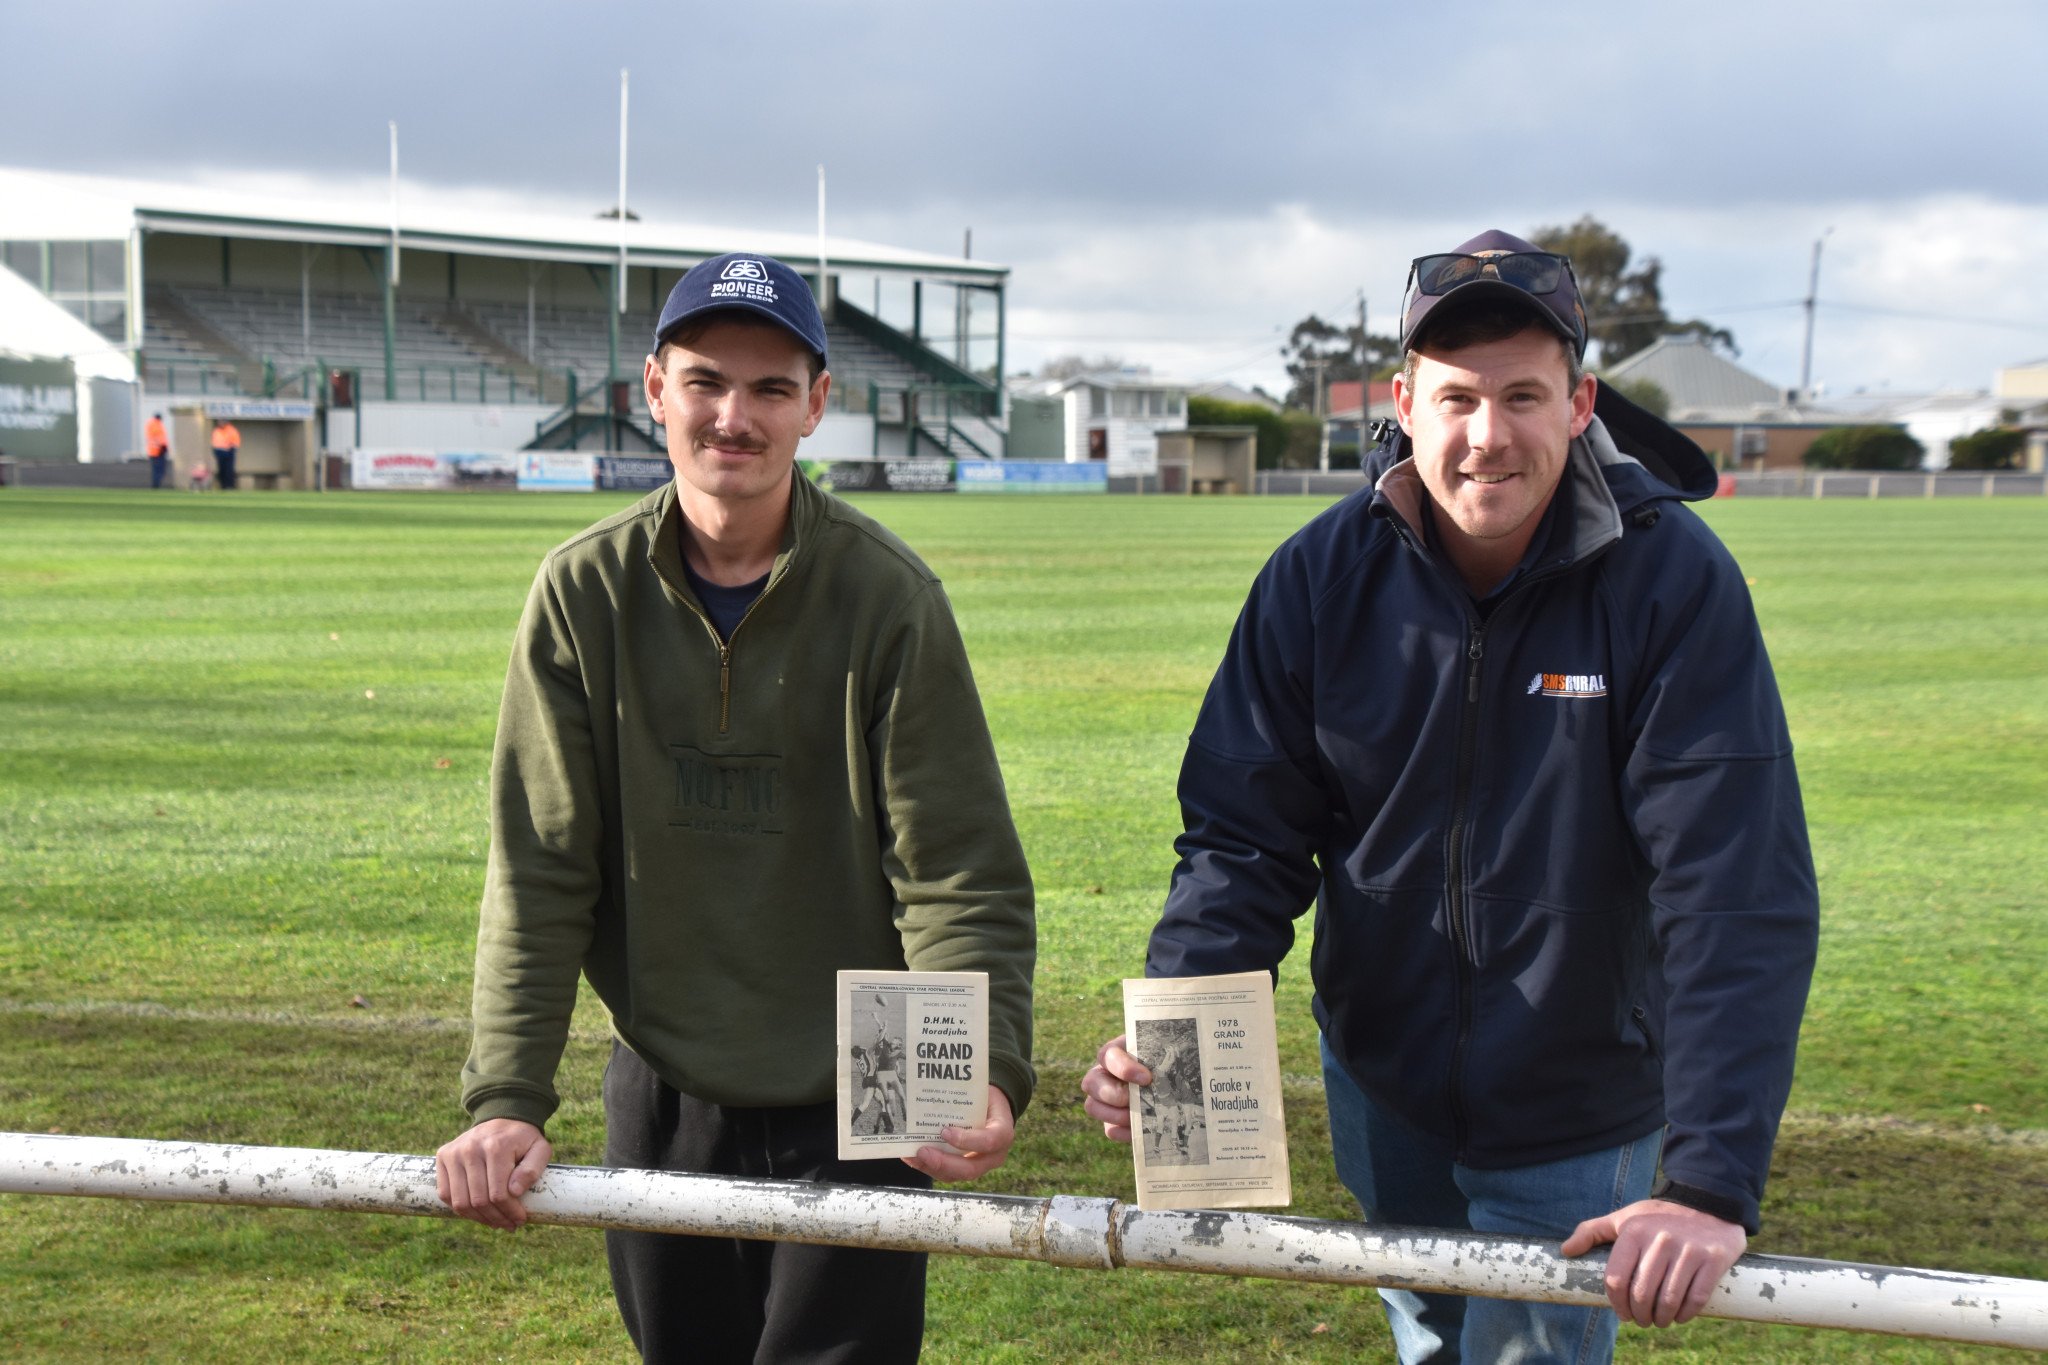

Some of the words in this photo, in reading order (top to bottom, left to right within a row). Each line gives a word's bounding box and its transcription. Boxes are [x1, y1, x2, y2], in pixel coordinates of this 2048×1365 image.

[712, 281, 773, 297] PIONEER
[1217, 1019, 1239, 1027] 1978
[921, 1027, 968, 1037] Noradjuha
[1213, 1030, 1246, 1039] GRAND
[916, 1042, 973, 1060] GRAND
[1217, 1041, 1244, 1050] FINAL
[917, 1062, 972, 1081] FINALS
[1209, 1077, 1242, 1093] Goroke
[1245, 1081, 1251, 1092] v
[1210, 1095, 1259, 1112] Noradjuha
